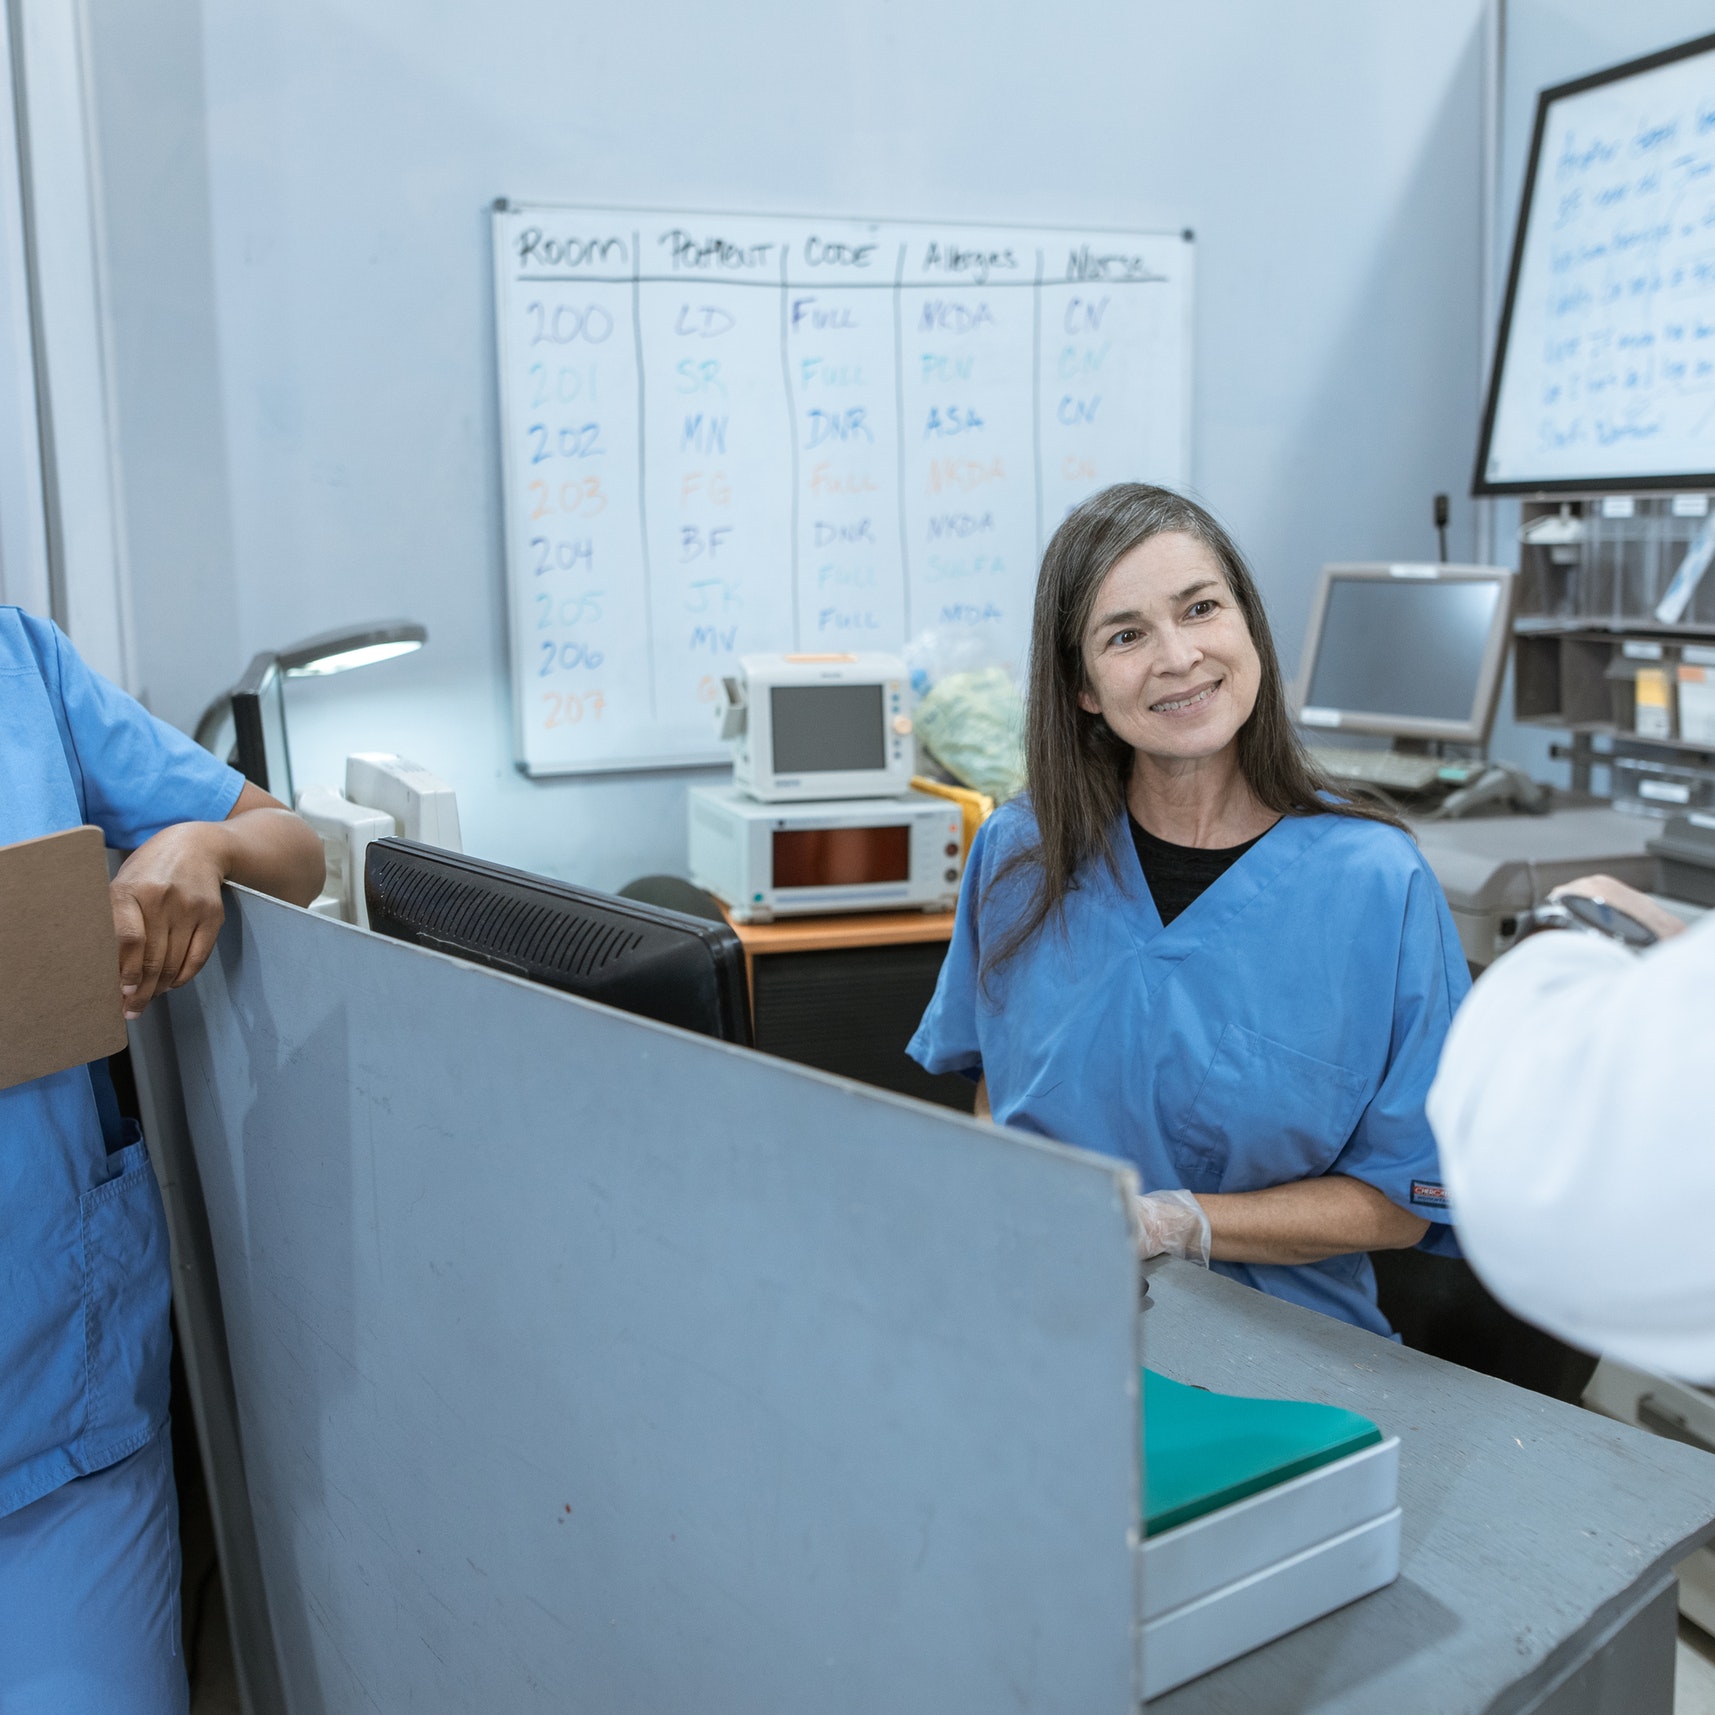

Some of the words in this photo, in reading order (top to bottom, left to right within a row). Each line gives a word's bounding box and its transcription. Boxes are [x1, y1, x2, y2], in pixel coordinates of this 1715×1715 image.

[527, 300, 615, 346] 200
[673, 303, 737, 338] LD
[527, 361, 598, 410] 201
[676, 358, 729, 396] SR
[528, 422, 607, 465] 202
[528, 476, 608, 521] 203
[530, 535, 594, 576] 204
[678, 524, 733, 564] BF
[536, 589, 605, 630] 205
[540, 640, 606, 678] 206
[543, 688, 606, 730] 207
